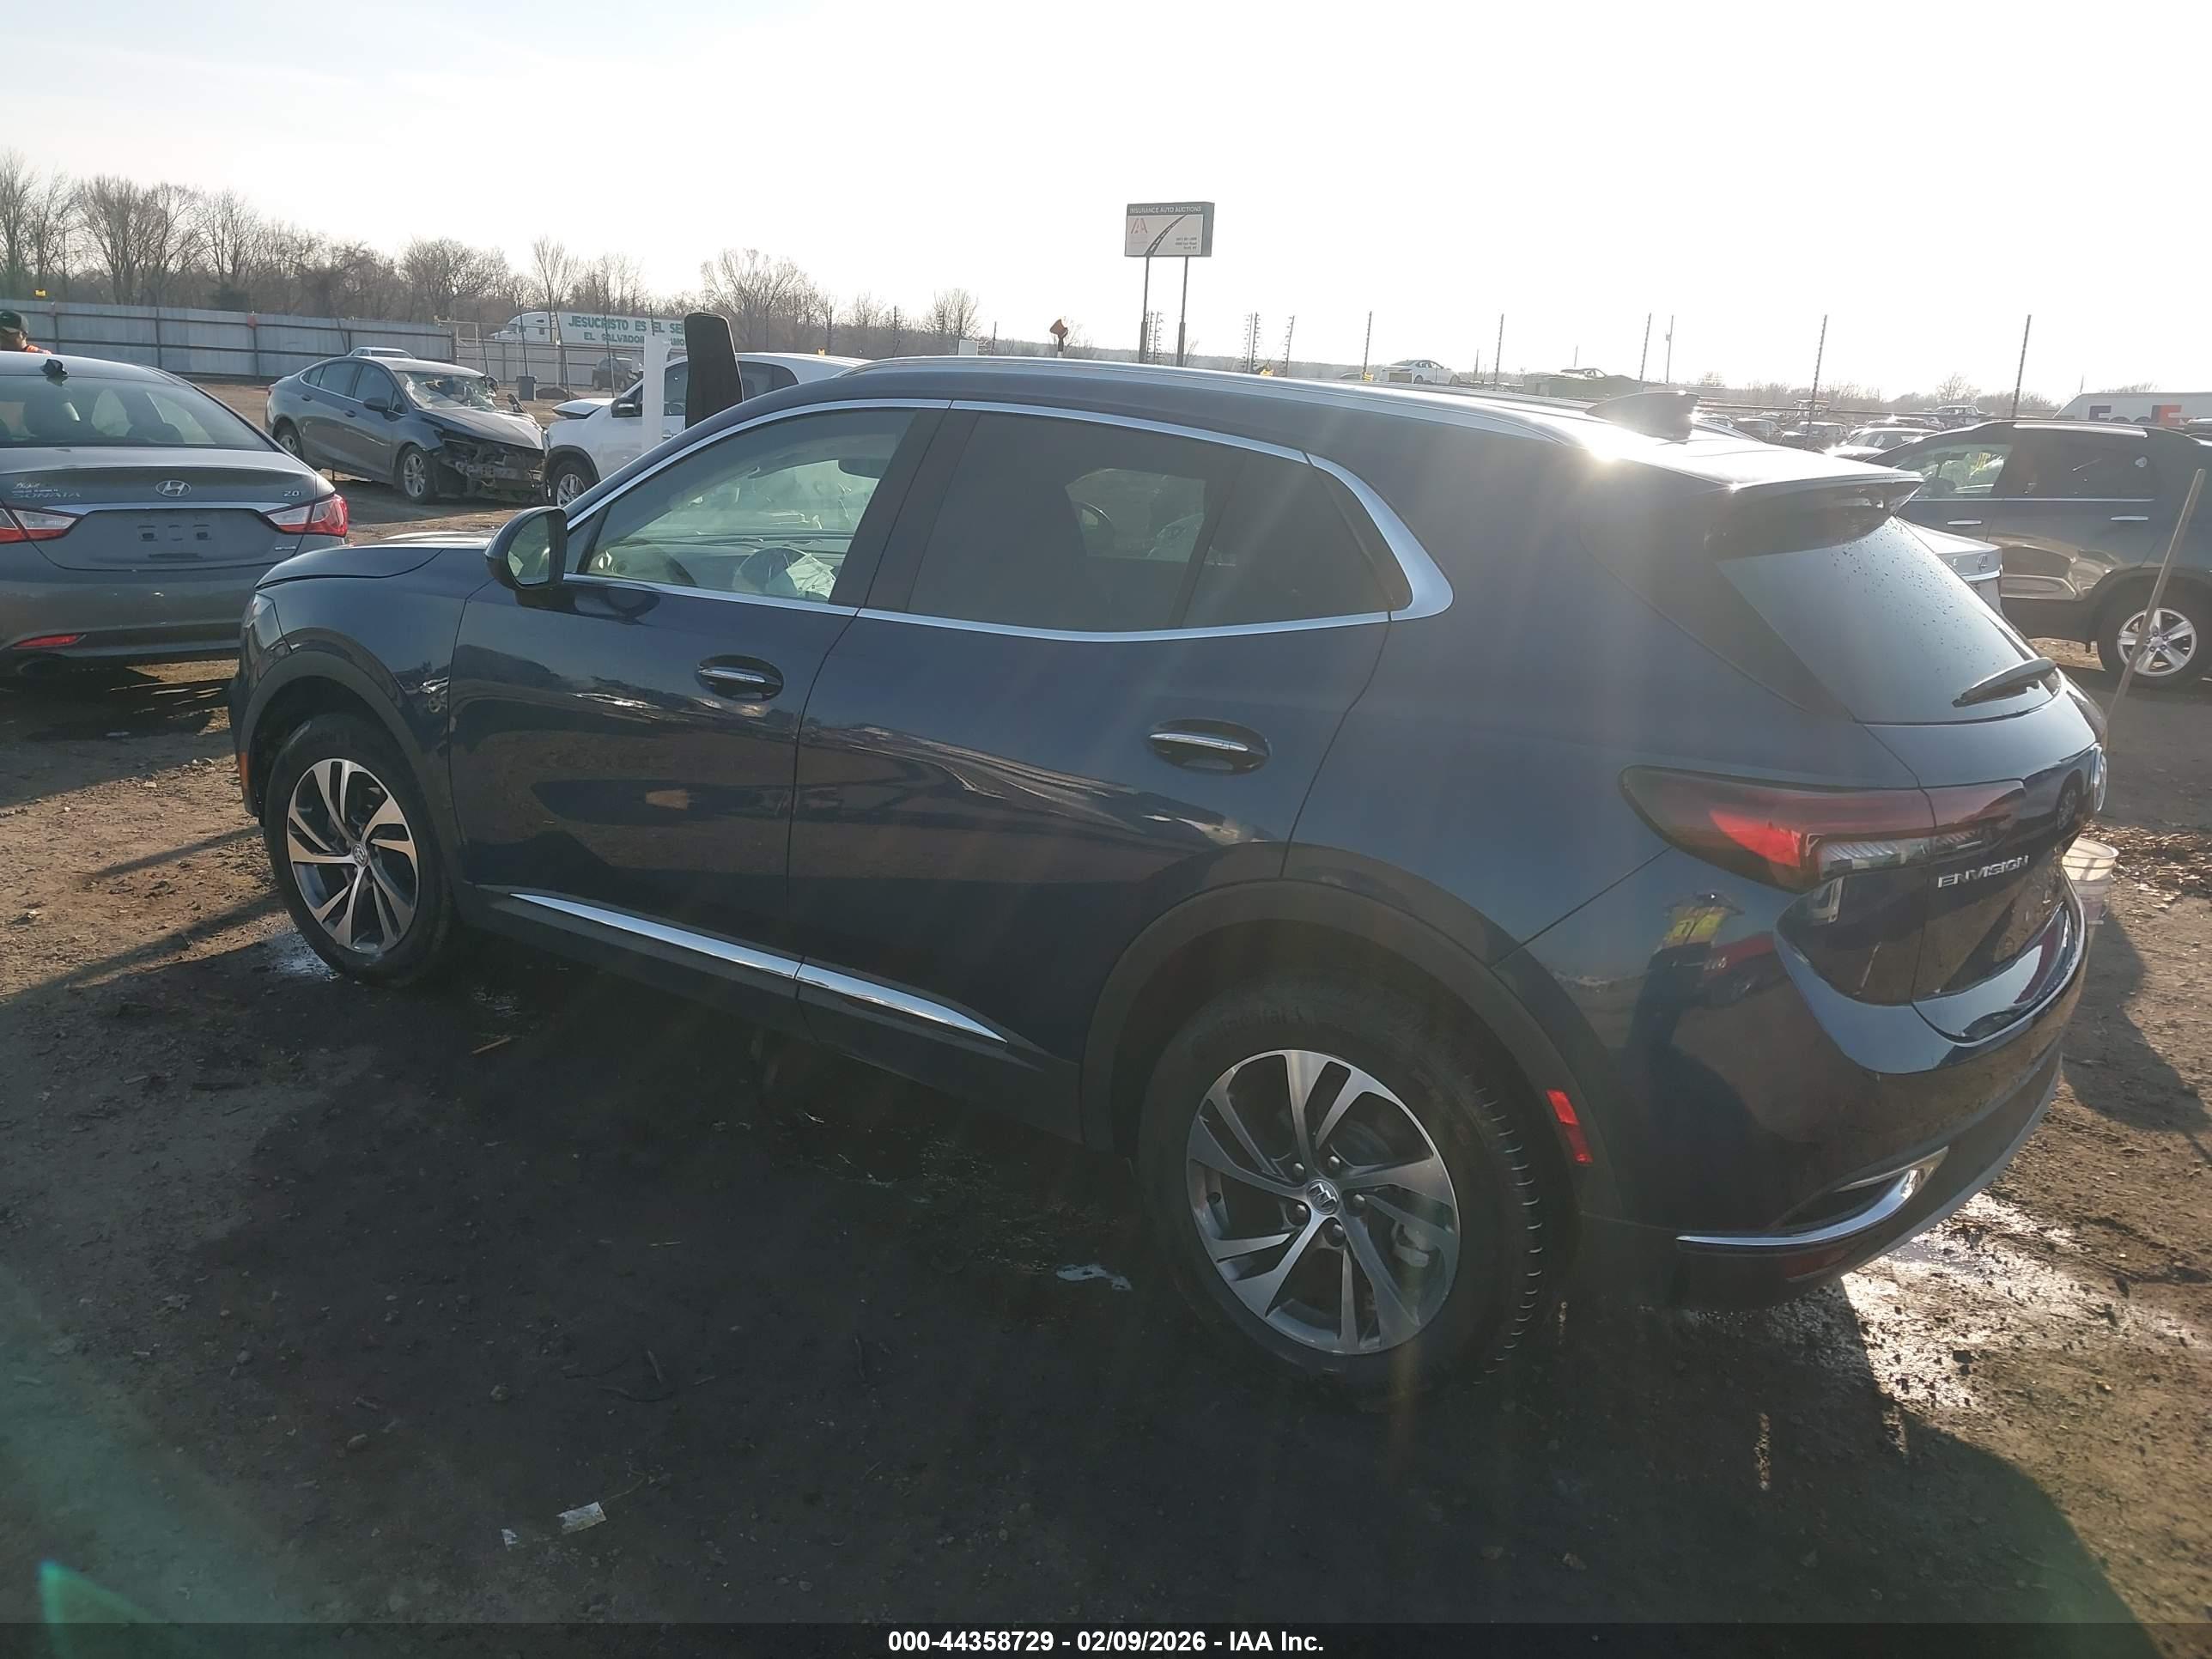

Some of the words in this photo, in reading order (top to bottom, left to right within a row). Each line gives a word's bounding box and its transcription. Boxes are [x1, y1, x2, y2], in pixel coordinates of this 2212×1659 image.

[568, 315, 629, 331] JESUCRISTO
[635, 320, 647, 332] ES
[584, 331, 596, 341] EL
[1937, 854, 2029, 888] ENVISION
